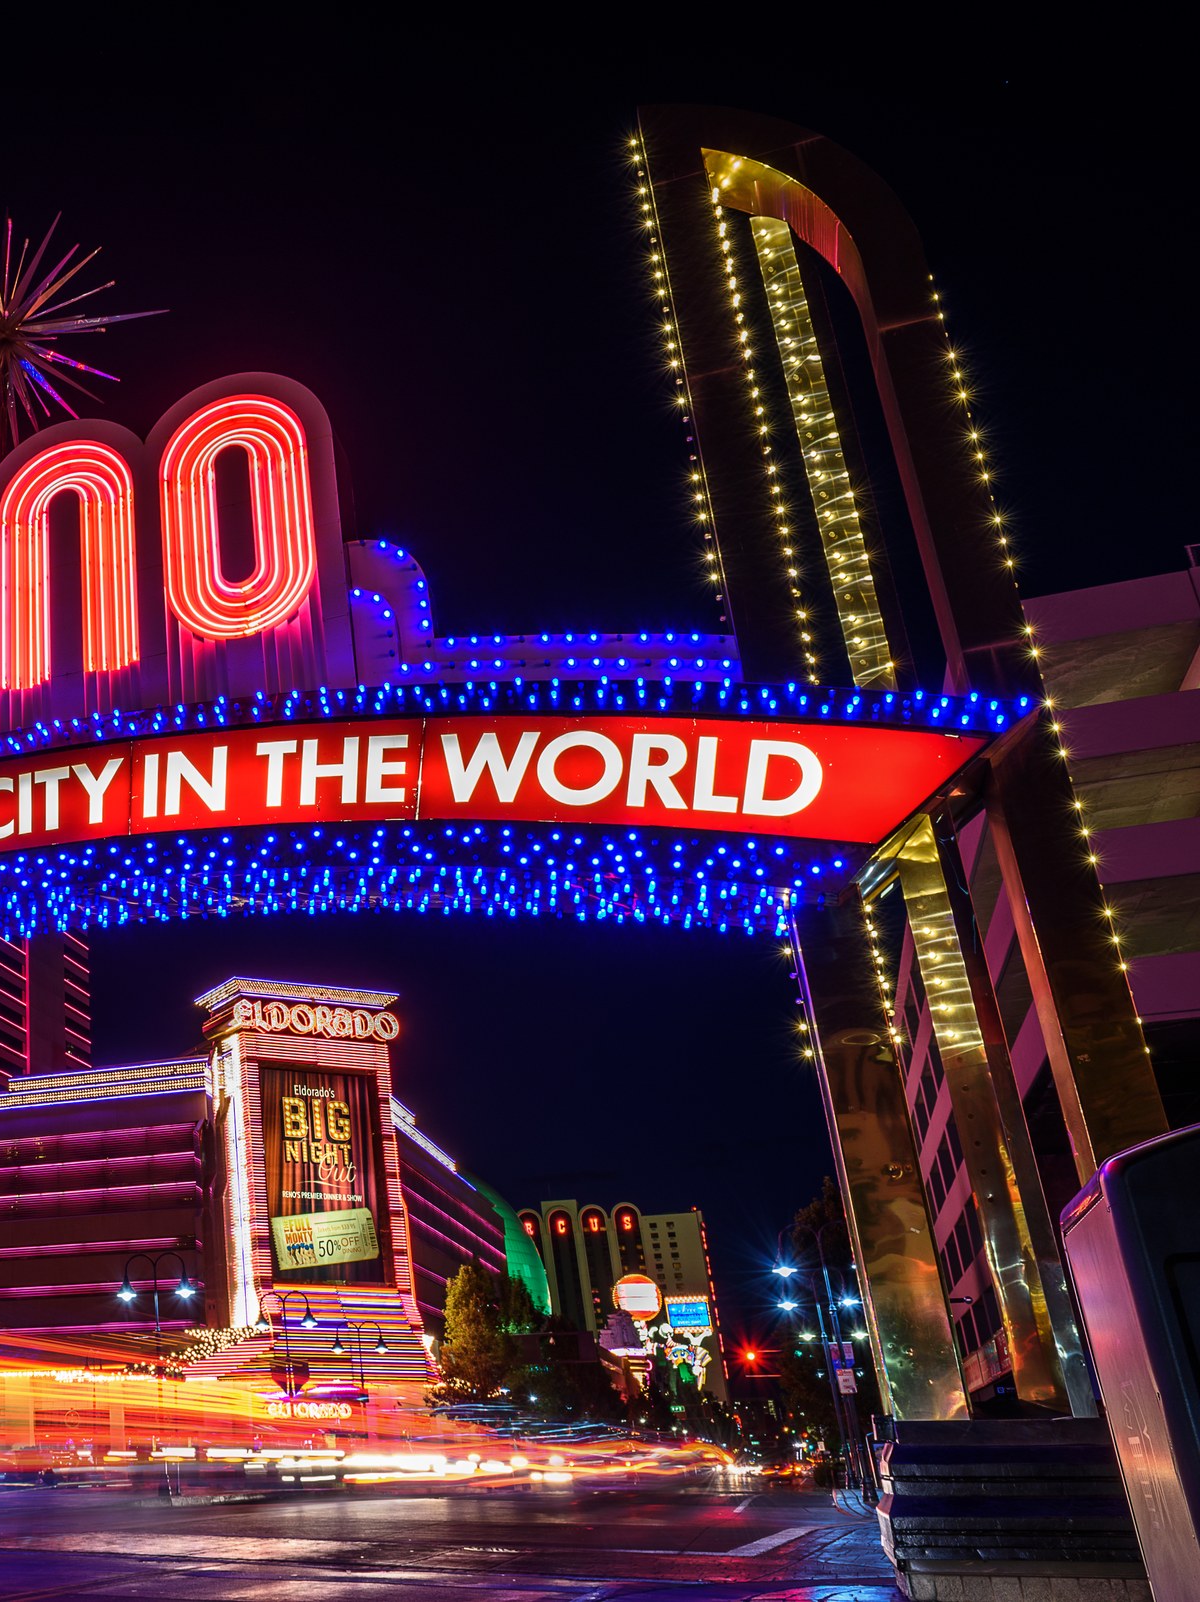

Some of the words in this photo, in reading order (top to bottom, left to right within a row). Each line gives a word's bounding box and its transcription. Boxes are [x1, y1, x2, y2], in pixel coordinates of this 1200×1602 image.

[143, 746, 228, 818] IN
[256, 734, 409, 807] THE
[440, 730, 824, 817] WORLD
[231, 999, 399, 1041] ELDORADO
[293, 1085, 335, 1098] Eldorado's
[282, 1097, 352, 1142] BIG
[284, 1140, 351, 1166] NIGHT
[318, 1151, 357, 1183] Out
[282, 1191, 301, 1199] RENO'S
[301, 1191, 323, 1200] PREMIER
[323, 1193, 342, 1201] DINNER
[347, 1194, 363, 1203] SHOW
[289, 1217, 313, 1232] FULL
[285, 1231, 313, 1245] MONTY
[318, 1239, 342, 1258] 50%
[341, 1236, 360, 1247] OFF
[342, 1246, 362, 1255] DINING
